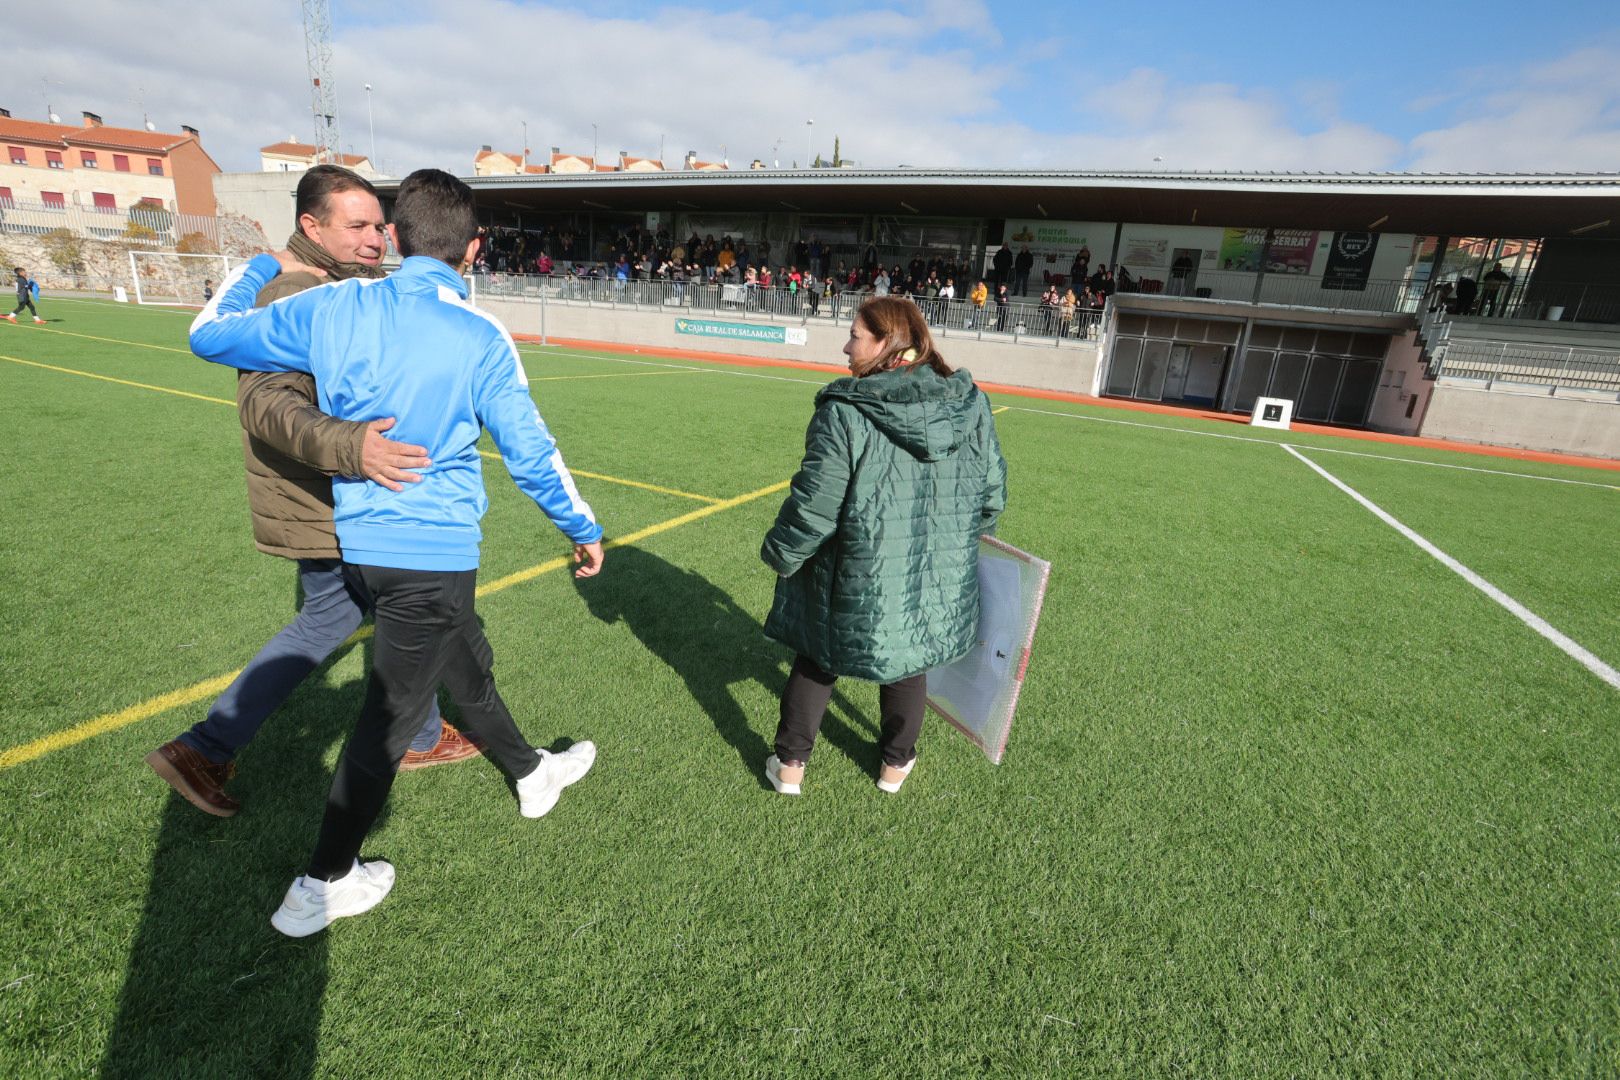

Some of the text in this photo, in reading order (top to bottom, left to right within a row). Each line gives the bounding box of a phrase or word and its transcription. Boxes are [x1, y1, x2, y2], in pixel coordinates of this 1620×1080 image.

[688, 324, 704, 333] CAJA
[705, 325, 727, 334] RURAL
[728, 327, 738, 336] DE
[738, 328, 783, 339] SALAMANCA
